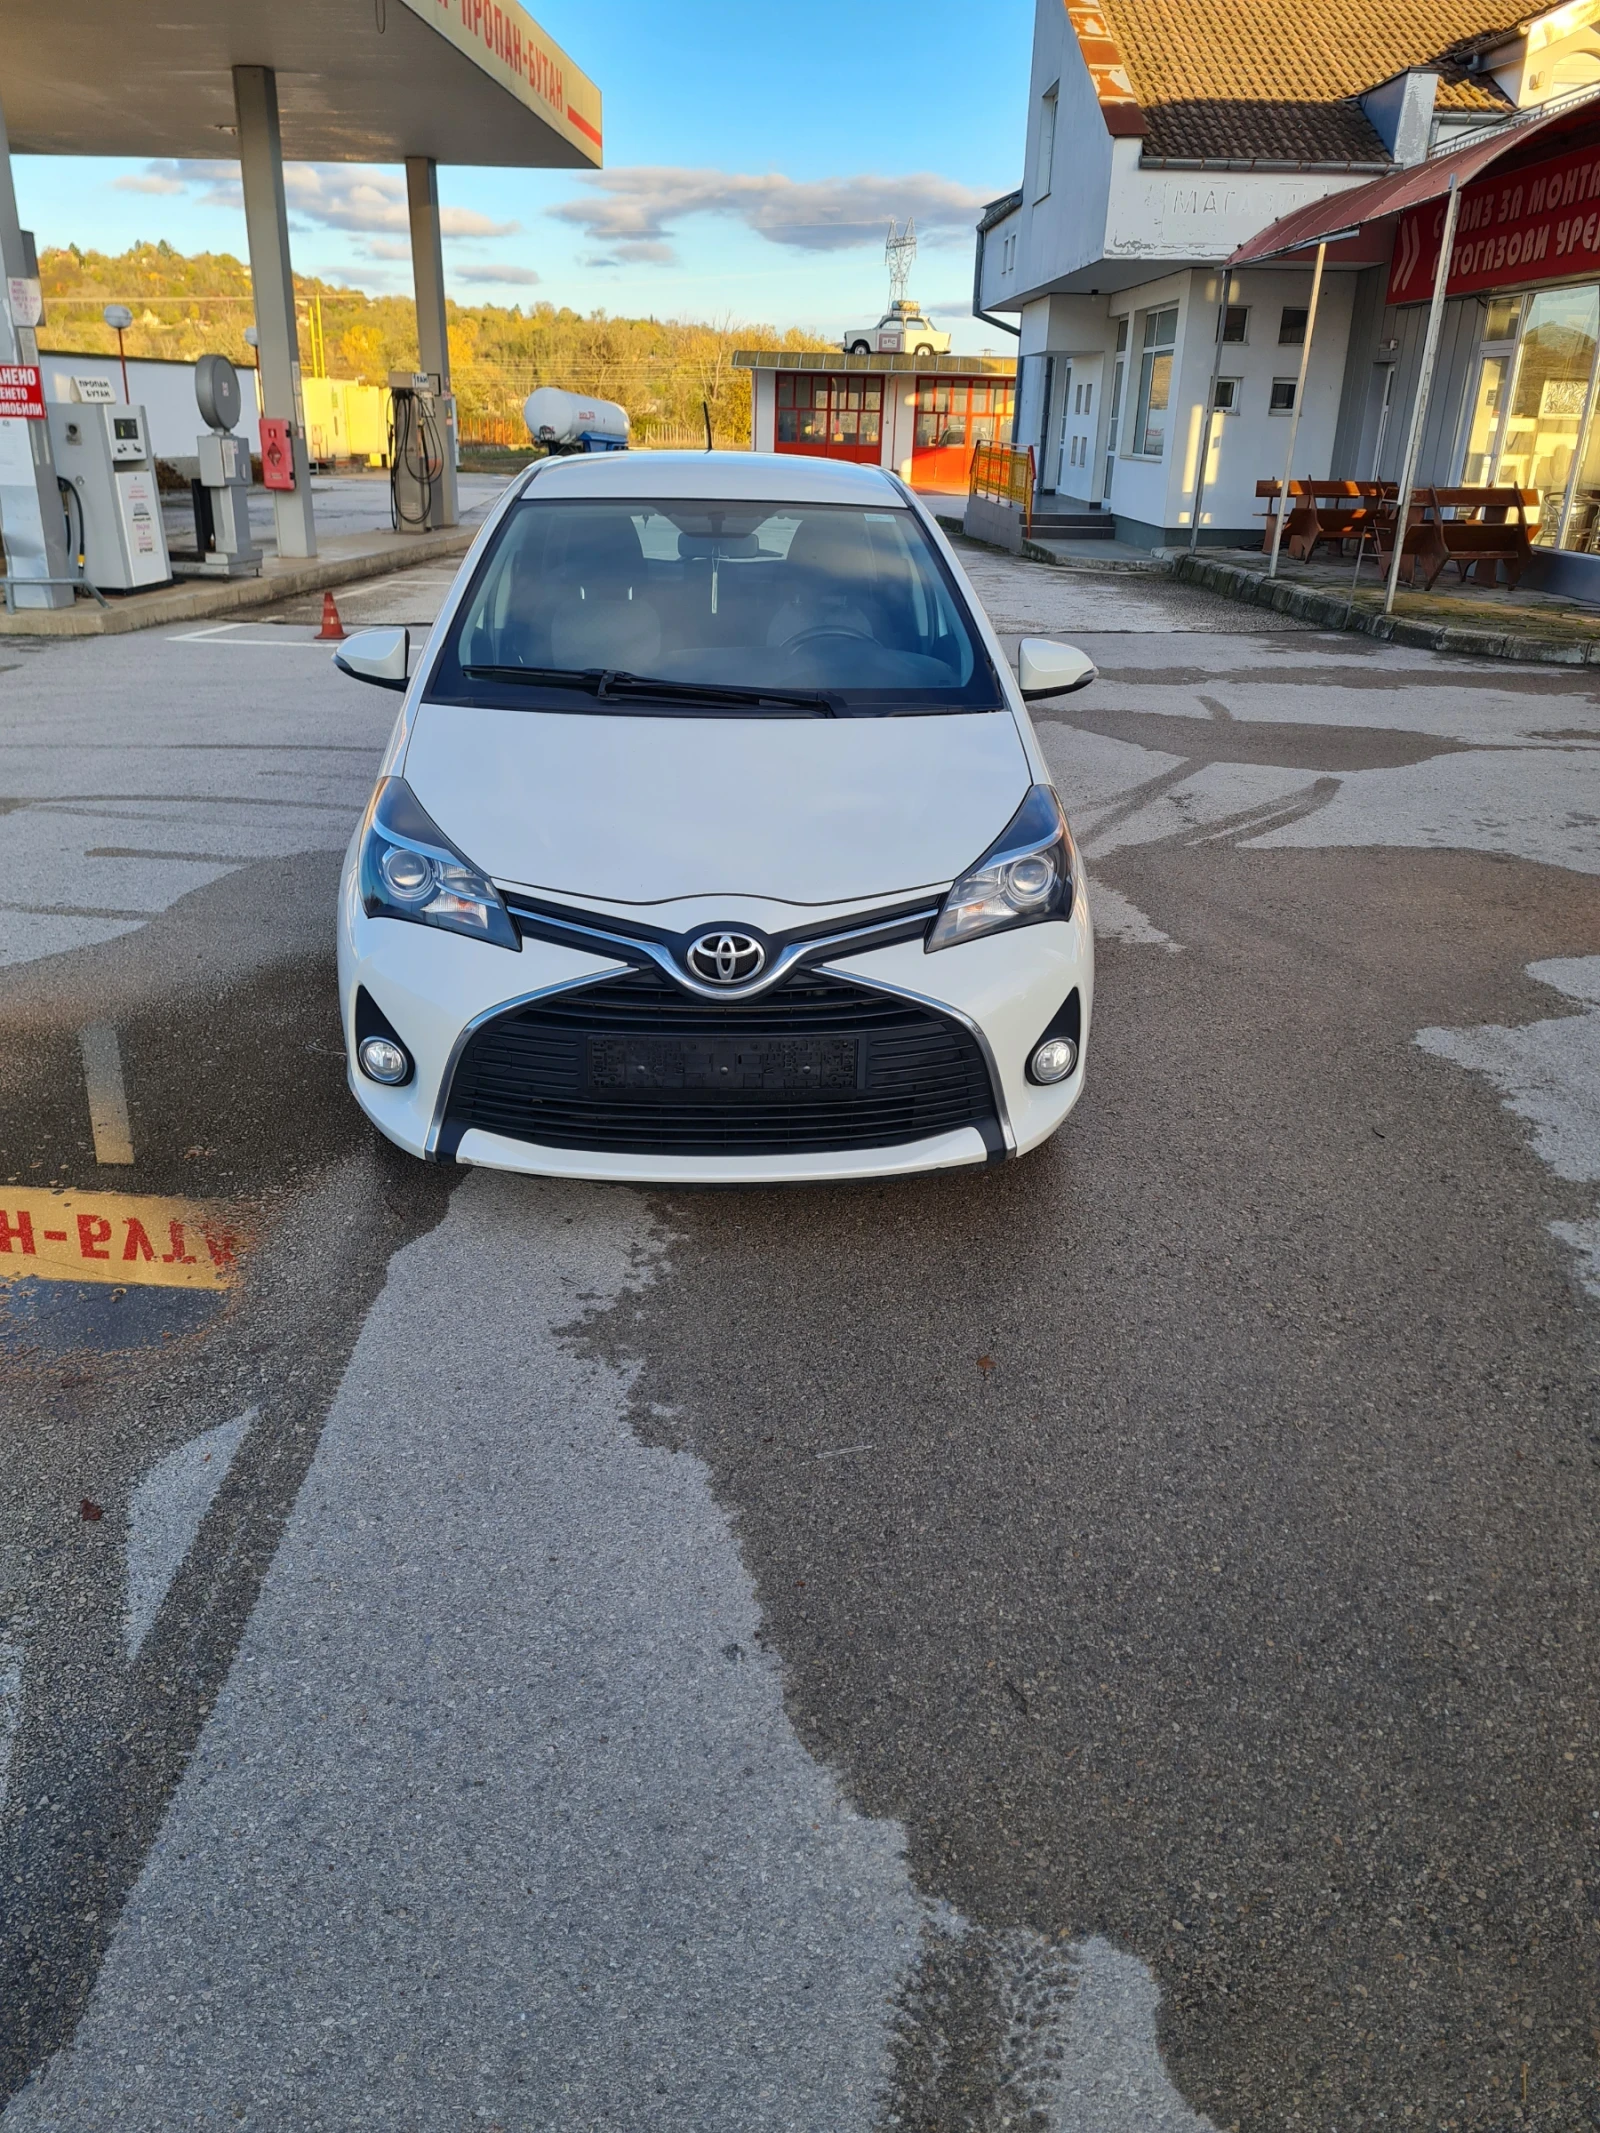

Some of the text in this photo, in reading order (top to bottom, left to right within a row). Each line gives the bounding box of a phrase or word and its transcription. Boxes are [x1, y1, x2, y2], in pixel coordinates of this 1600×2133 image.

[1433, 194, 1494, 238] СВИЗ
[1497, 185, 1523, 222] ЗА
[1431, 224, 1550, 280] ТОГАЗОВИ
[0, 387, 28, 400] ЕНЕТО
